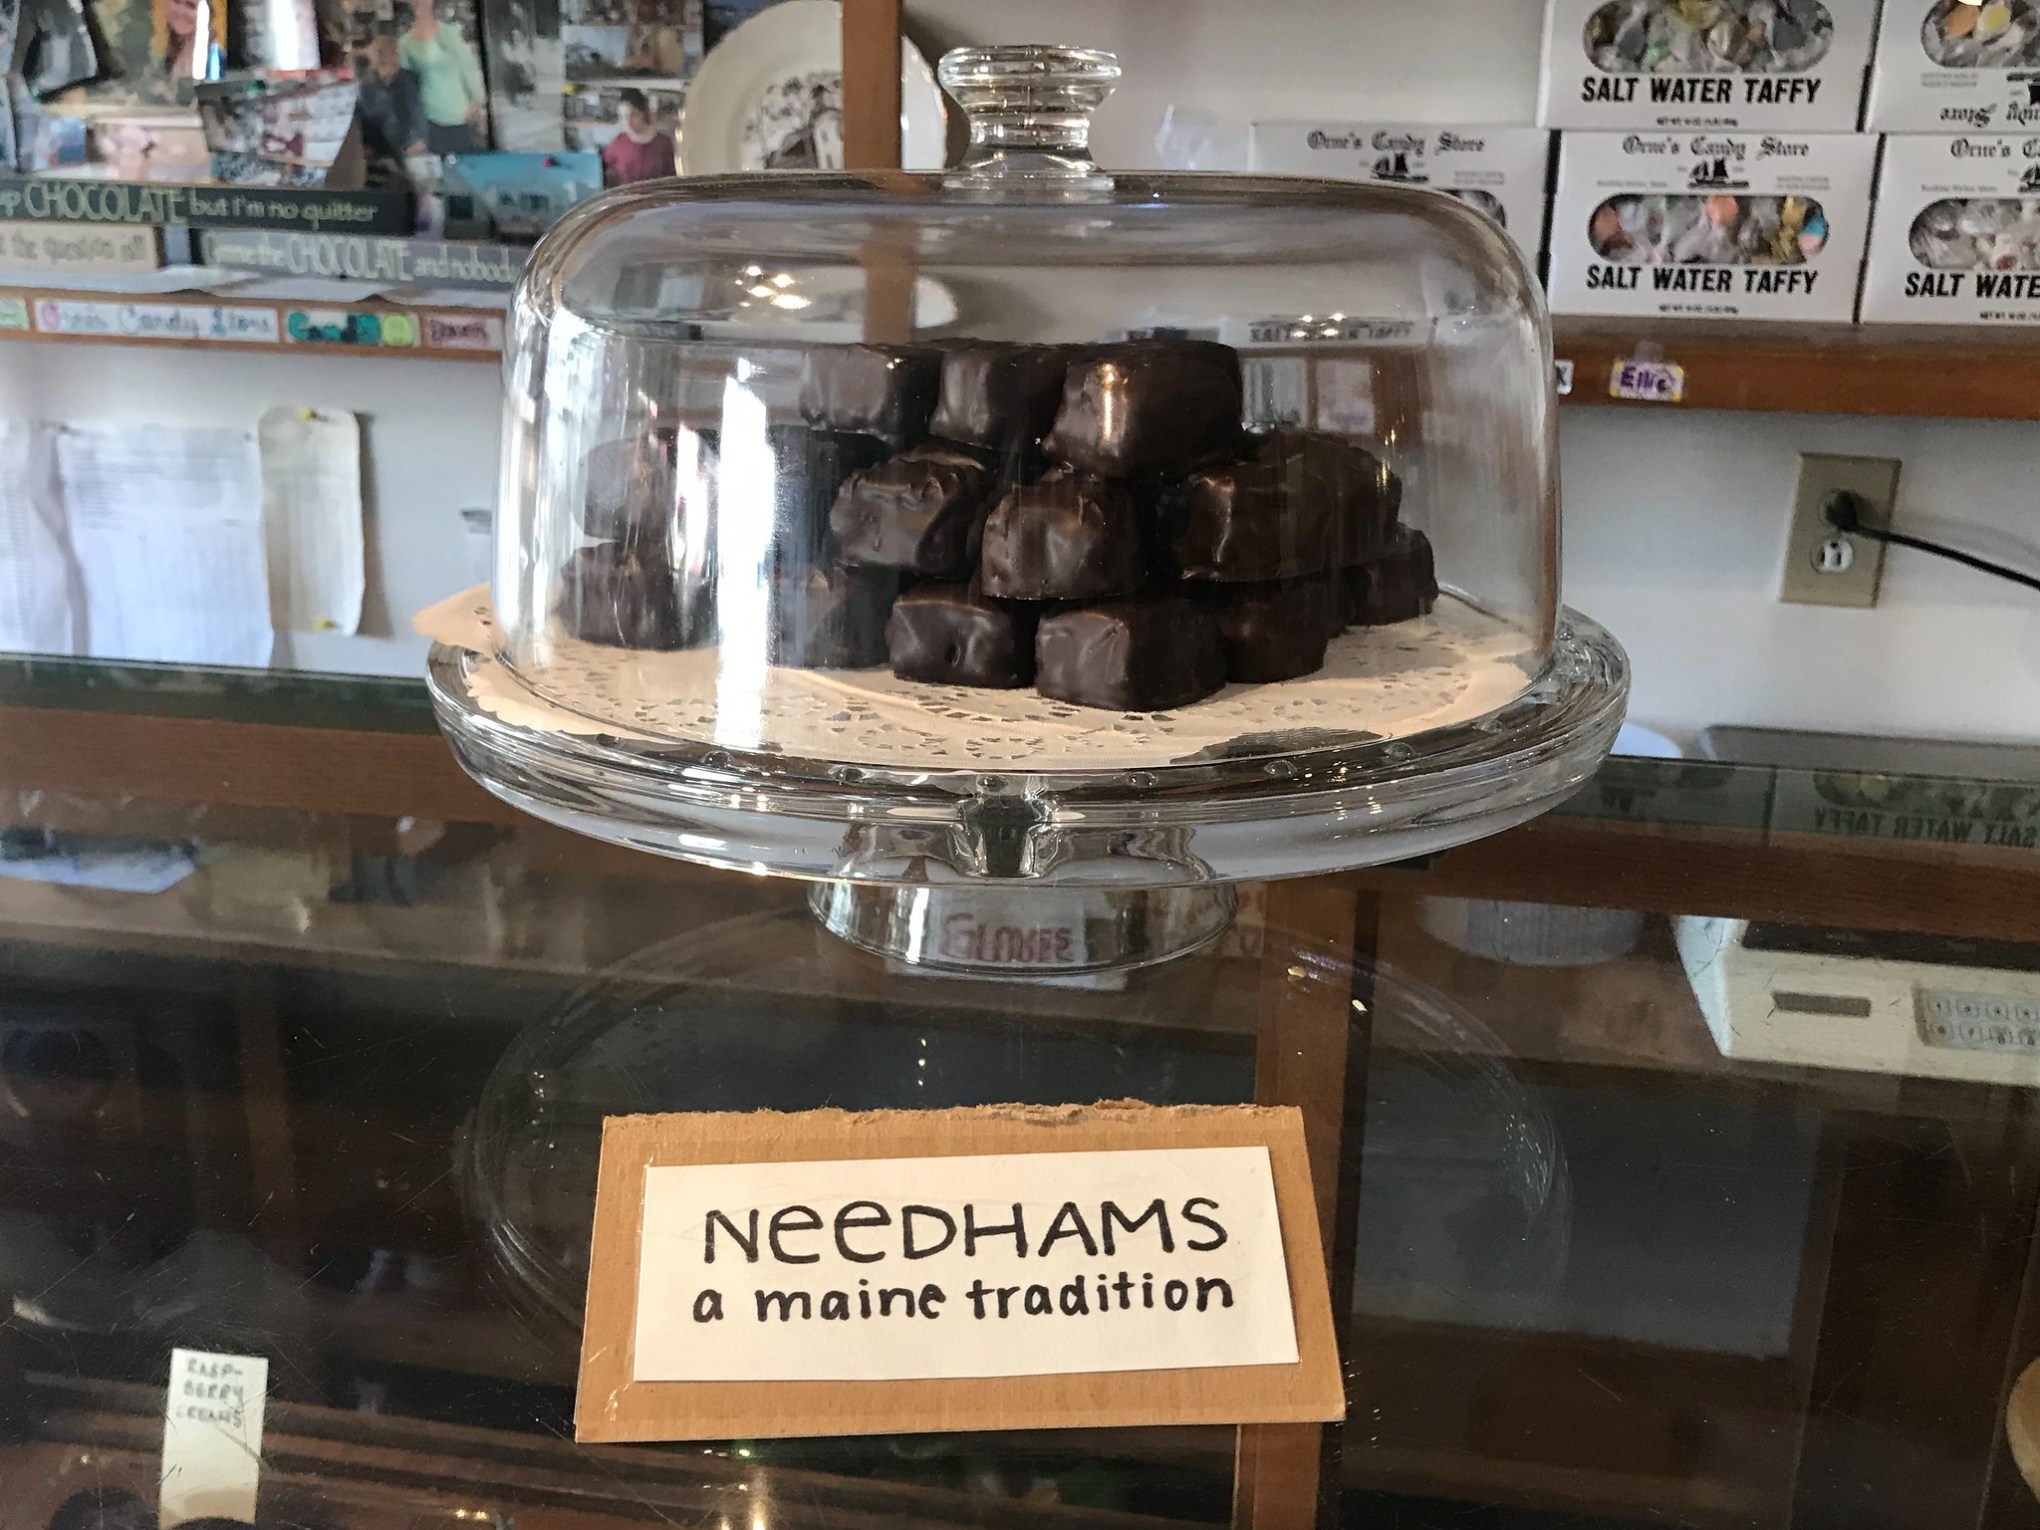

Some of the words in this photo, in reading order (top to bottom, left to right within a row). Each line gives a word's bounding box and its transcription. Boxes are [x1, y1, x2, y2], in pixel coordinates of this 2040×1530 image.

[1581, 77, 1639, 102] SALT
[1649, 78, 1733, 103] WATER
[1743, 78, 1822, 104] TAFFY
[1370, 130, 1426, 156] Candy
[1434, 131, 1485, 156] Store
[1690, 136, 1746, 160] Candy
[1756, 136, 1810, 161] Store
[23, 181, 187, 225] CHOCOLATE
[190, 189, 227, 216] but
[267, 201, 299, 219] no
[302, 202, 378, 232] quitter
[286, 233, 414, 281] CHOCOLATE
[1586, 264, 1642, 290] SALT
[1653, 267, 1733, 293] WATER
[1744, 269, 1818, 295] TAFFY
[1904, 272, 1965, 297] SALT
[1976, 273, 2040, 299] WATE
[692, 1287, 724, 1323] a
[756, 1278, 947, 1323] maine
[965, 1271, 1235, 1320] tradition
